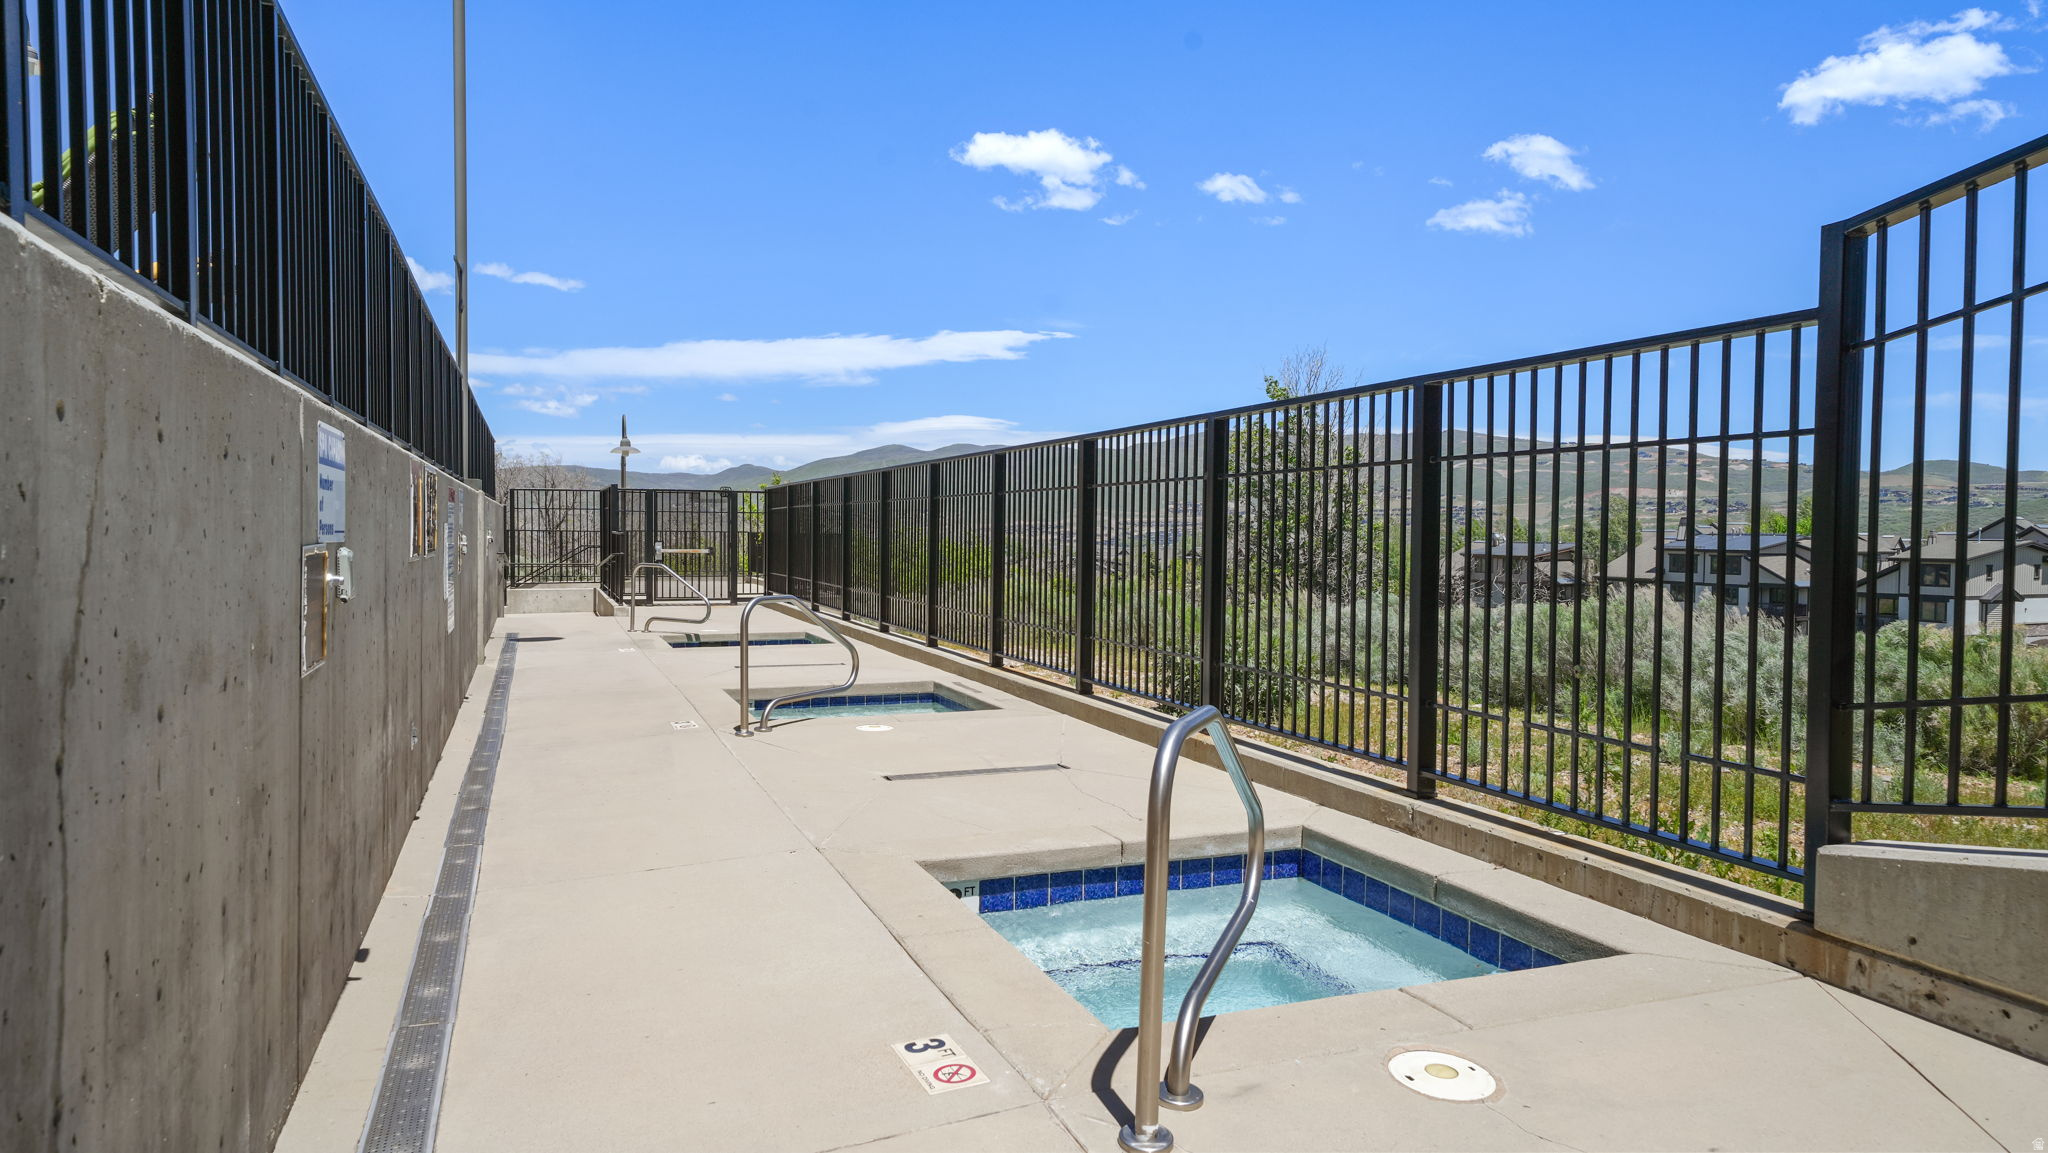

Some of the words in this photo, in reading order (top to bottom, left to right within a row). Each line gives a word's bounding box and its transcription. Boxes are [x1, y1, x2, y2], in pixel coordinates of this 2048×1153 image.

[319, 473, 334, 491] Number
[319, 519, 334, 535] Persons
[964, 886, 976, 897] FT
[904, 1038, 945, 1053] 3
